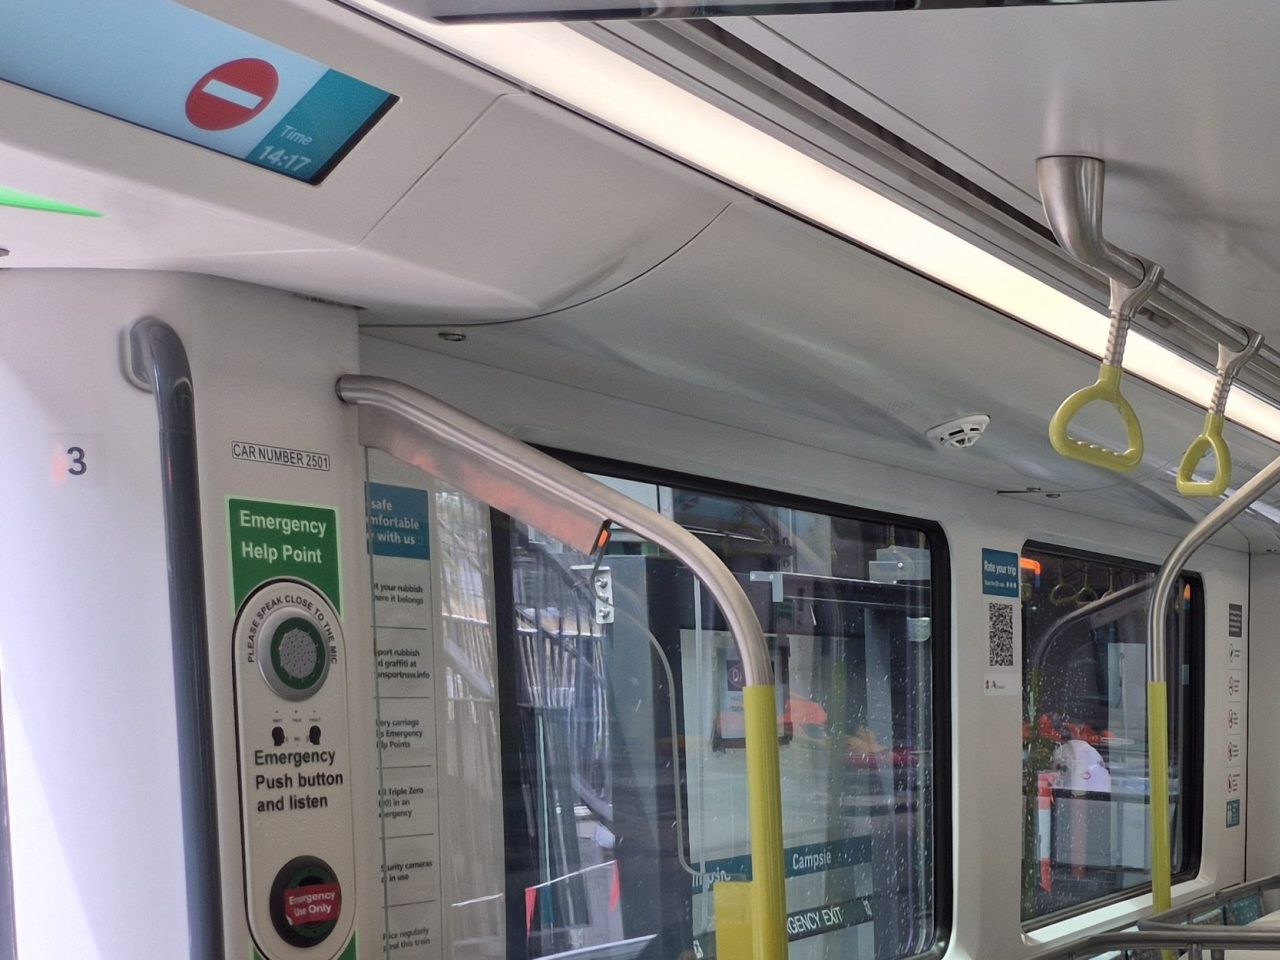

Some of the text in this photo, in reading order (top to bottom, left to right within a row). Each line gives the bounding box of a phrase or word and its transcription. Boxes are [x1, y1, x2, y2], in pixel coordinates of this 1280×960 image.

[281, 124, 312, 145] Time
[258, 145, 312, 172] 14:17
[66, 446, 87, 476] 3
[233, 442, 328, 469] CAR NUMBER 2501
[371, 498, 392, 511] safe
[240, 510, 327, 537] Emergency
[371, 514, 420, 530] mfortable
[377, 530, 401, 544] with
[404, 535, 416, 544] us
[242, 542, 322, 564] Help Point
[984, 560, 996, 572] Rate
[1008, 564, 1017, 577] trip
[380, 584, 396, 592] your
[398, 584, 423, 592] rubbish
[390, 594, 396, 602] it
[397, 594, 424, 606] belongs
[248, 594, 338, 664] PLEASE SPEAK CLOSE TO THE MIC
[378, 648, 420, 657] port rubbish
[385, 659, 408, 668] graffiti
[392, 717, 419, 728] carriage
[386, 730, 422, 738] Emergency
[390, 740, 410, 748] Points
[254, 749, 336, 767] Emergency
[256, 772, 344, 790] Push button
[389, 787, 407, 797] Triple
[257, 794, 328, 812] and listen
[393, 798, 400, 806] in
[405, 861, 432, 869] cameras
[793, 849, 832, 870] Campsie
[289, 891, 336, 905] Emergency
[294, 904, 332, 916] Use Only
[786, 905, 842, 935] GENCY EXIT
[401, 939, 413, 948] this
[415, 938, 430, 946] train
